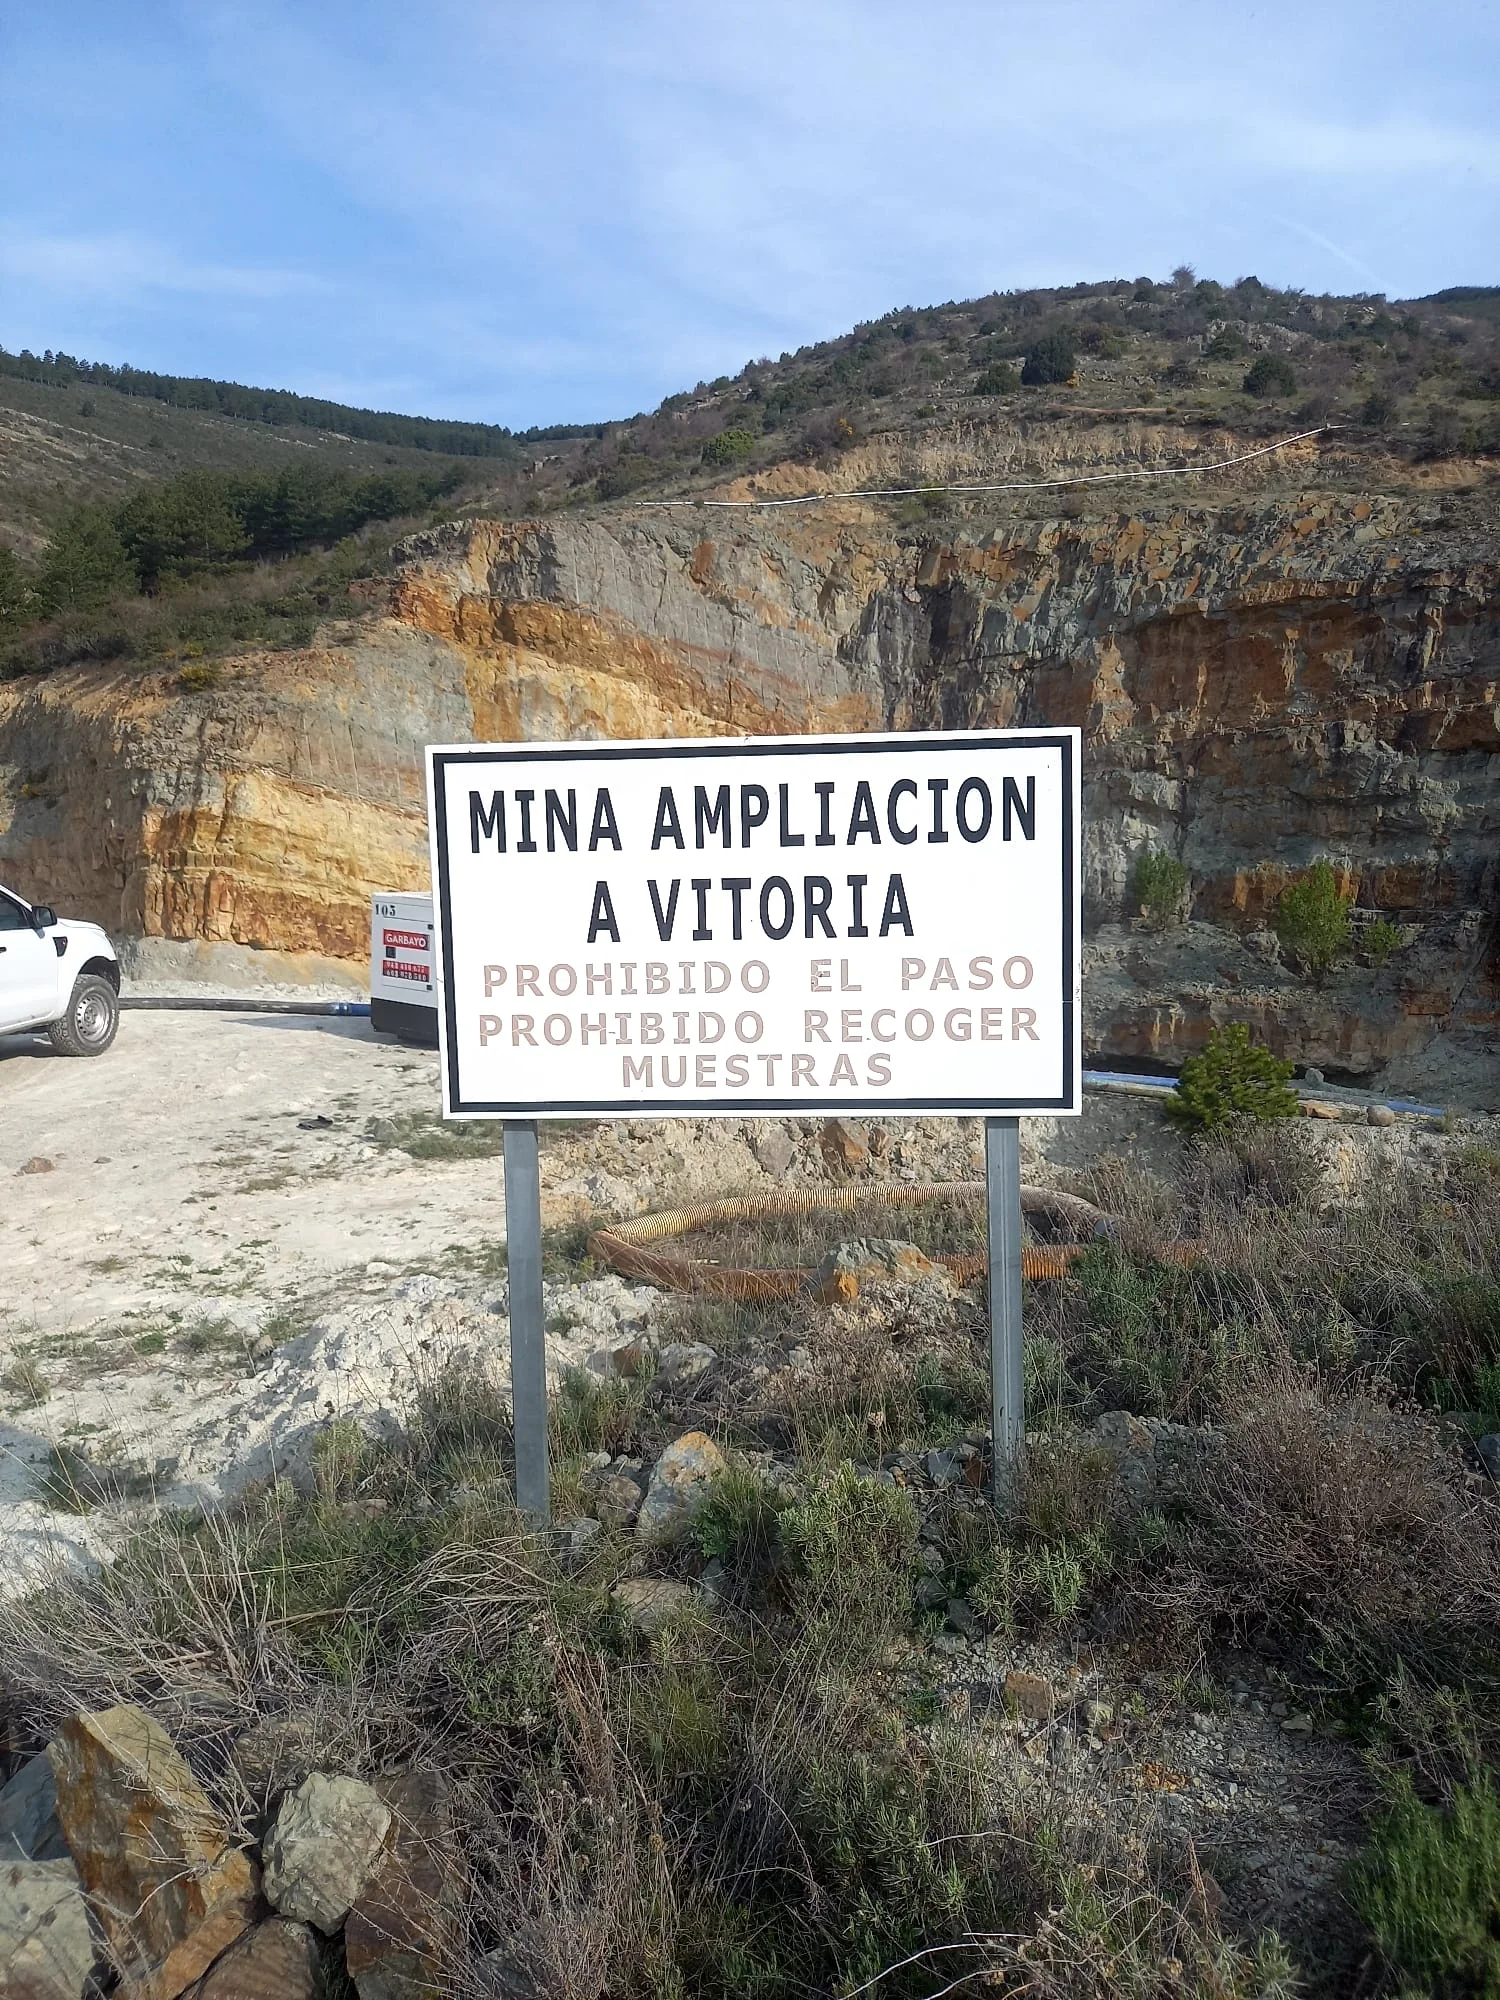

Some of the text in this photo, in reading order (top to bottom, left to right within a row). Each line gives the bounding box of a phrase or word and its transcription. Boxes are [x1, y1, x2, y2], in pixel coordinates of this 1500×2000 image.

[469, 776, 1036, 854] MINA AMPLIACION
[587, 873, 917, 944] A VITORIA
[386, 933, 427, 948] GARBAYO
[483, 956, 1034, 997] PROHIBIDO EL PASO
[478, 1007, 1041, 1046] PROHIBIDO RECOGER
[622, 1053, 892, 1088] MUESTRAS
